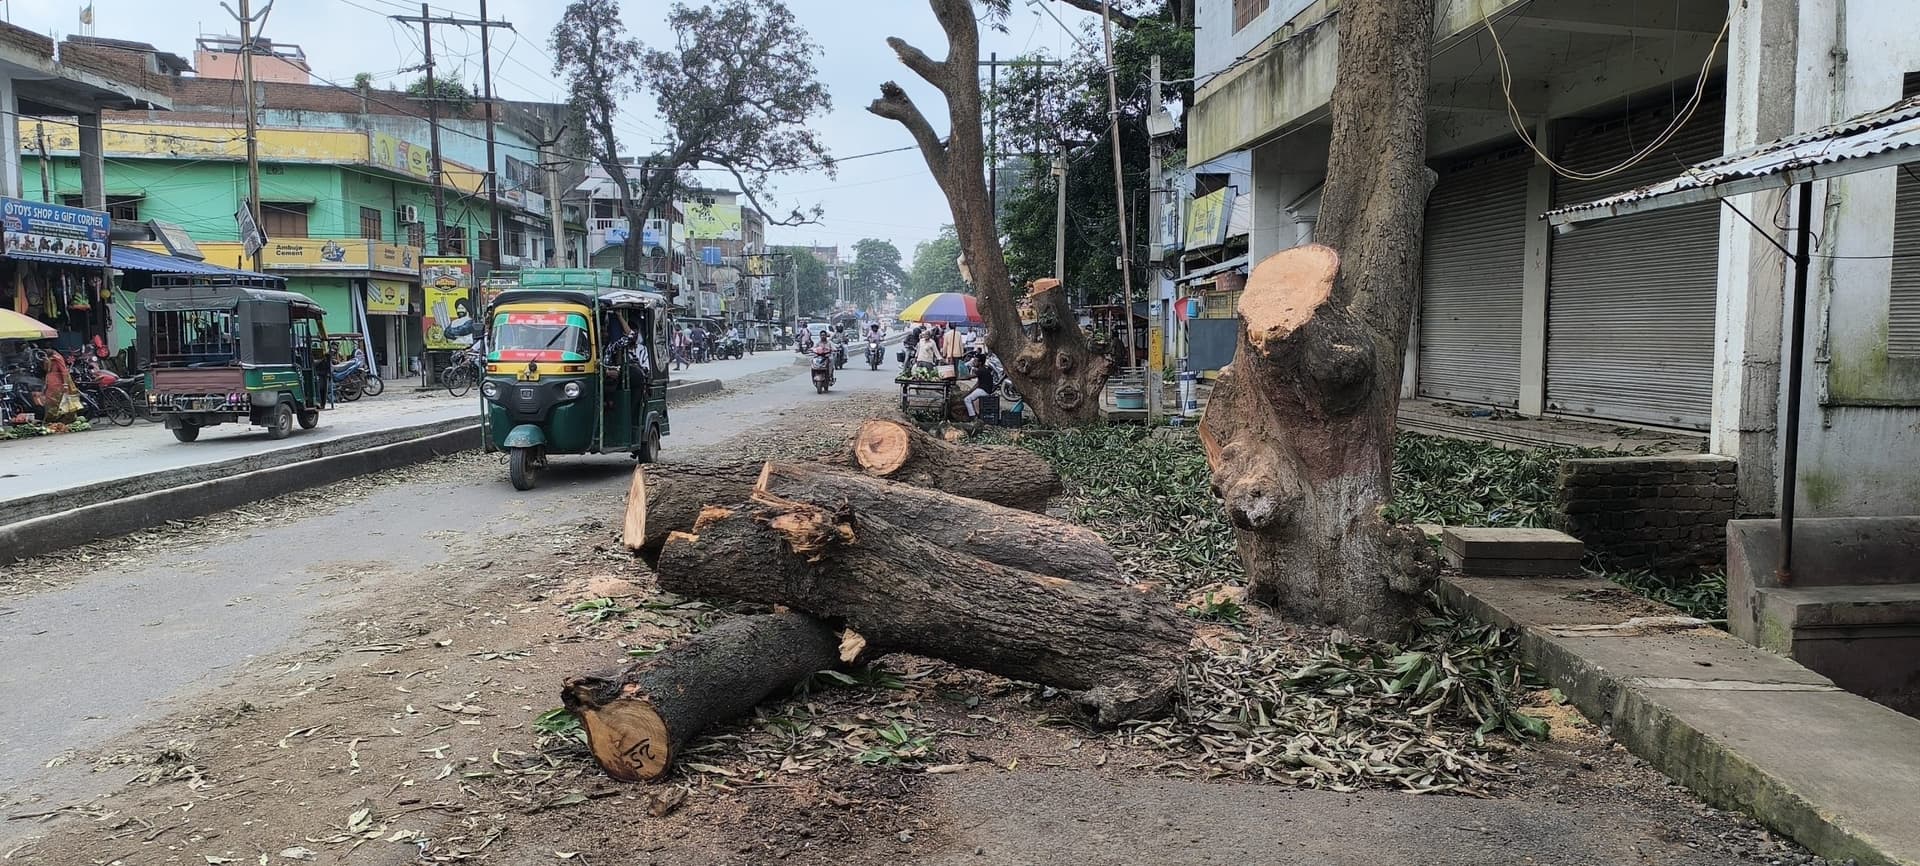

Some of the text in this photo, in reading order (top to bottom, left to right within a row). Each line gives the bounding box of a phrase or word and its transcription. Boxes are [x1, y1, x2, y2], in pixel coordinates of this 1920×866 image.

[13, 204, 104, 228] TOYS SHOP & GIFT CORNER
